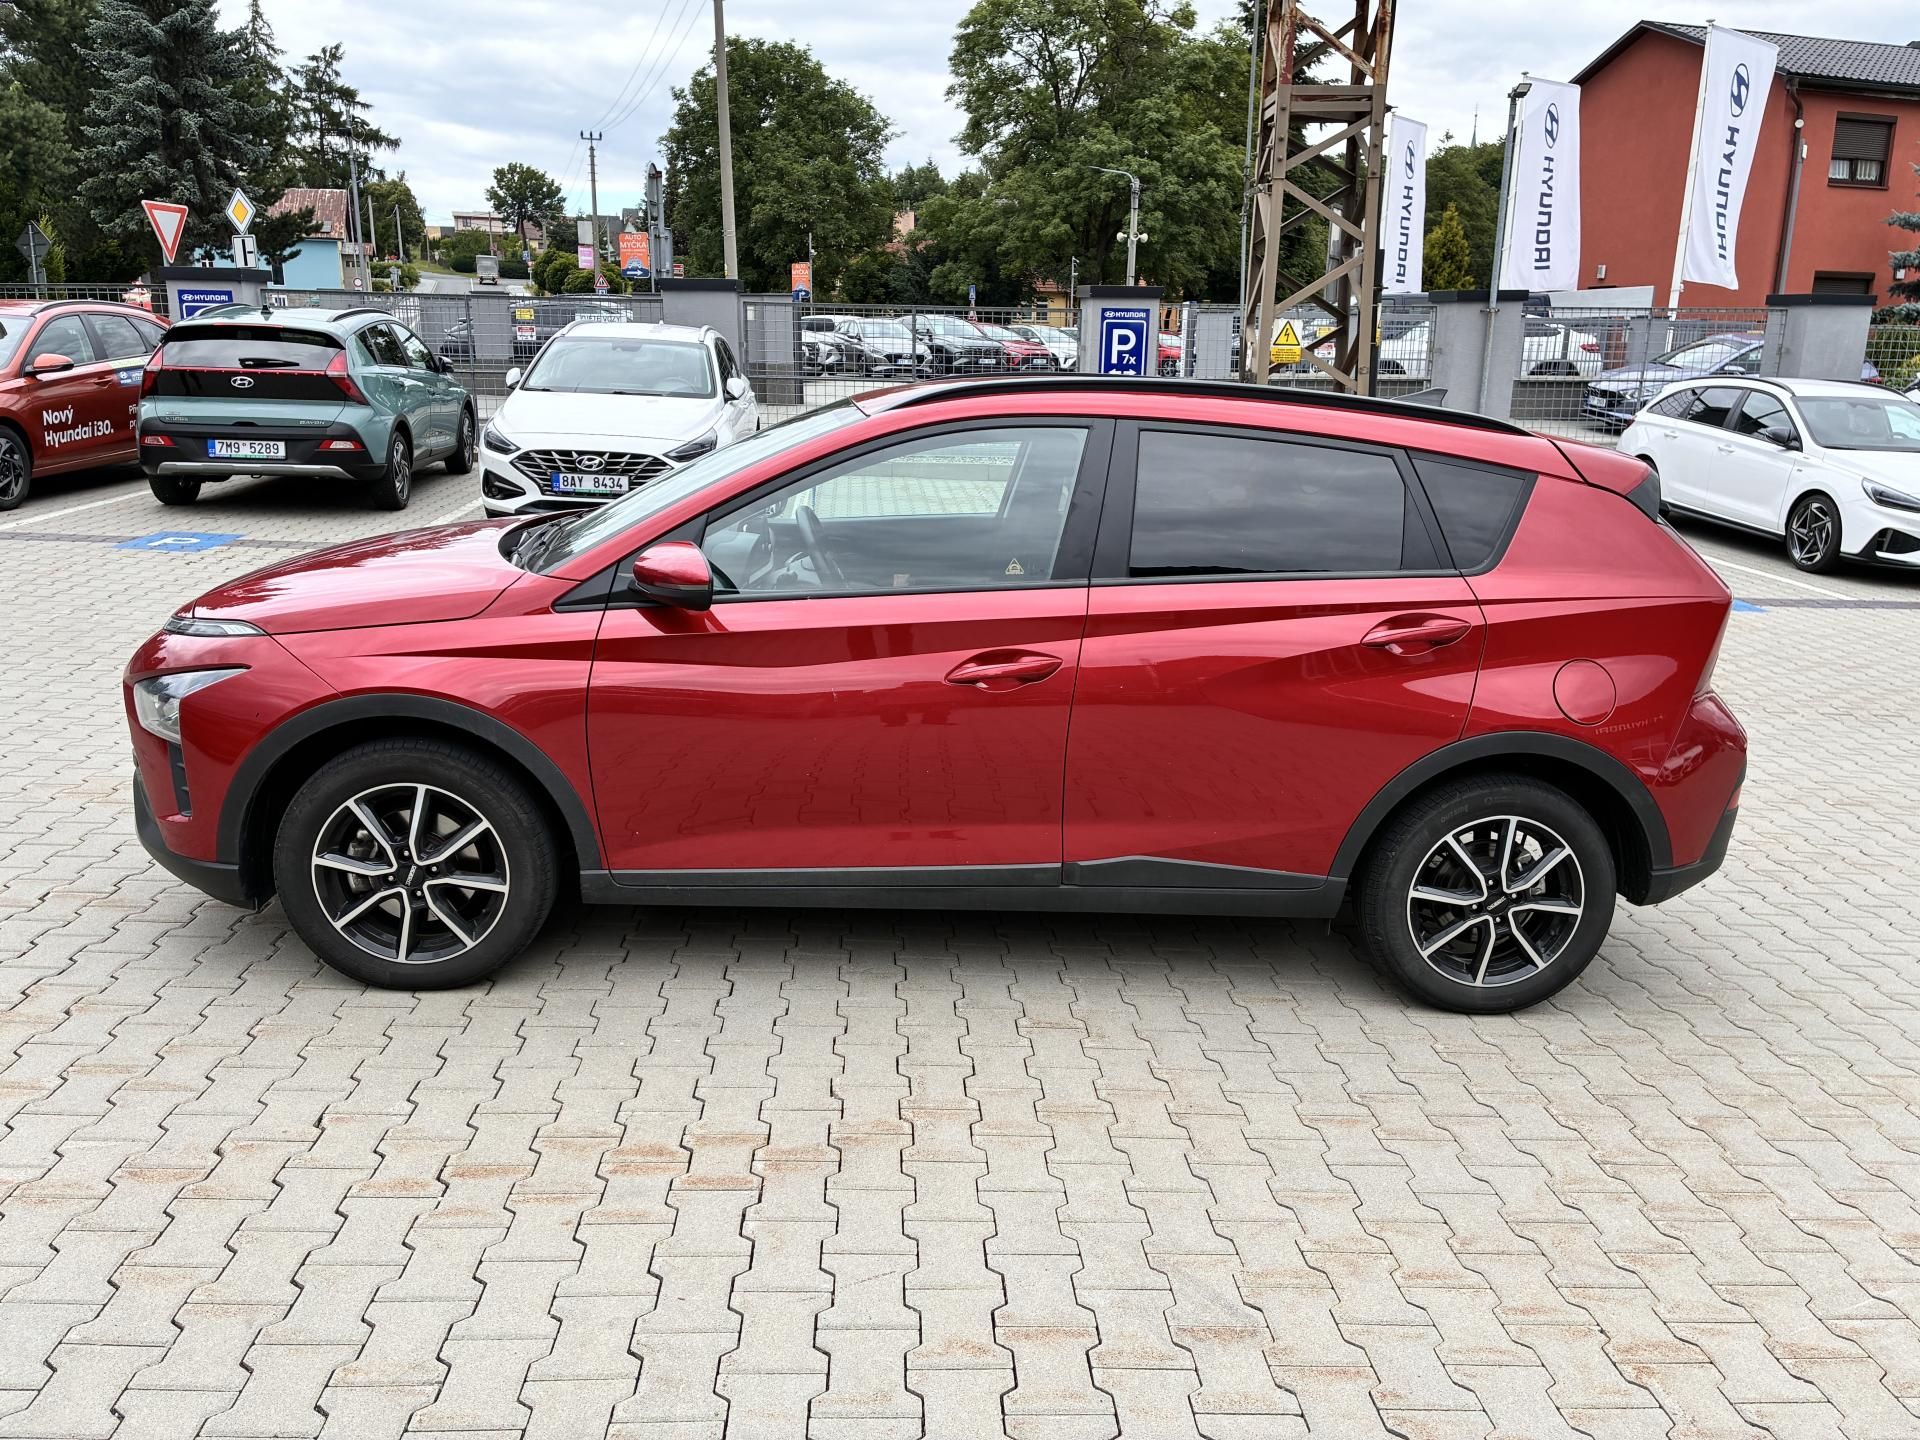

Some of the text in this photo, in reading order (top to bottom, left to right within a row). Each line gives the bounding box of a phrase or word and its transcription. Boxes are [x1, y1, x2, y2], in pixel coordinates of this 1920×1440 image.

[1715, 125, 1740, 261] HYUNDAI
[1534, 156, 1554, 270] HYUNDAI
[619, 240, 647, 249] MYČKA
[1395, 185, 1413, 284] HYUNDAI
[1111, 328, 1136, 364] P
[1121, 353, 1137, 365] 7x
[42, 404, 74, 426] Nový
[44, 419, 114, 448] Hyundai i30.
[217, 441, 279, 454] 7M9 5289
[562, 475, 622, 489] 8AY 8434
